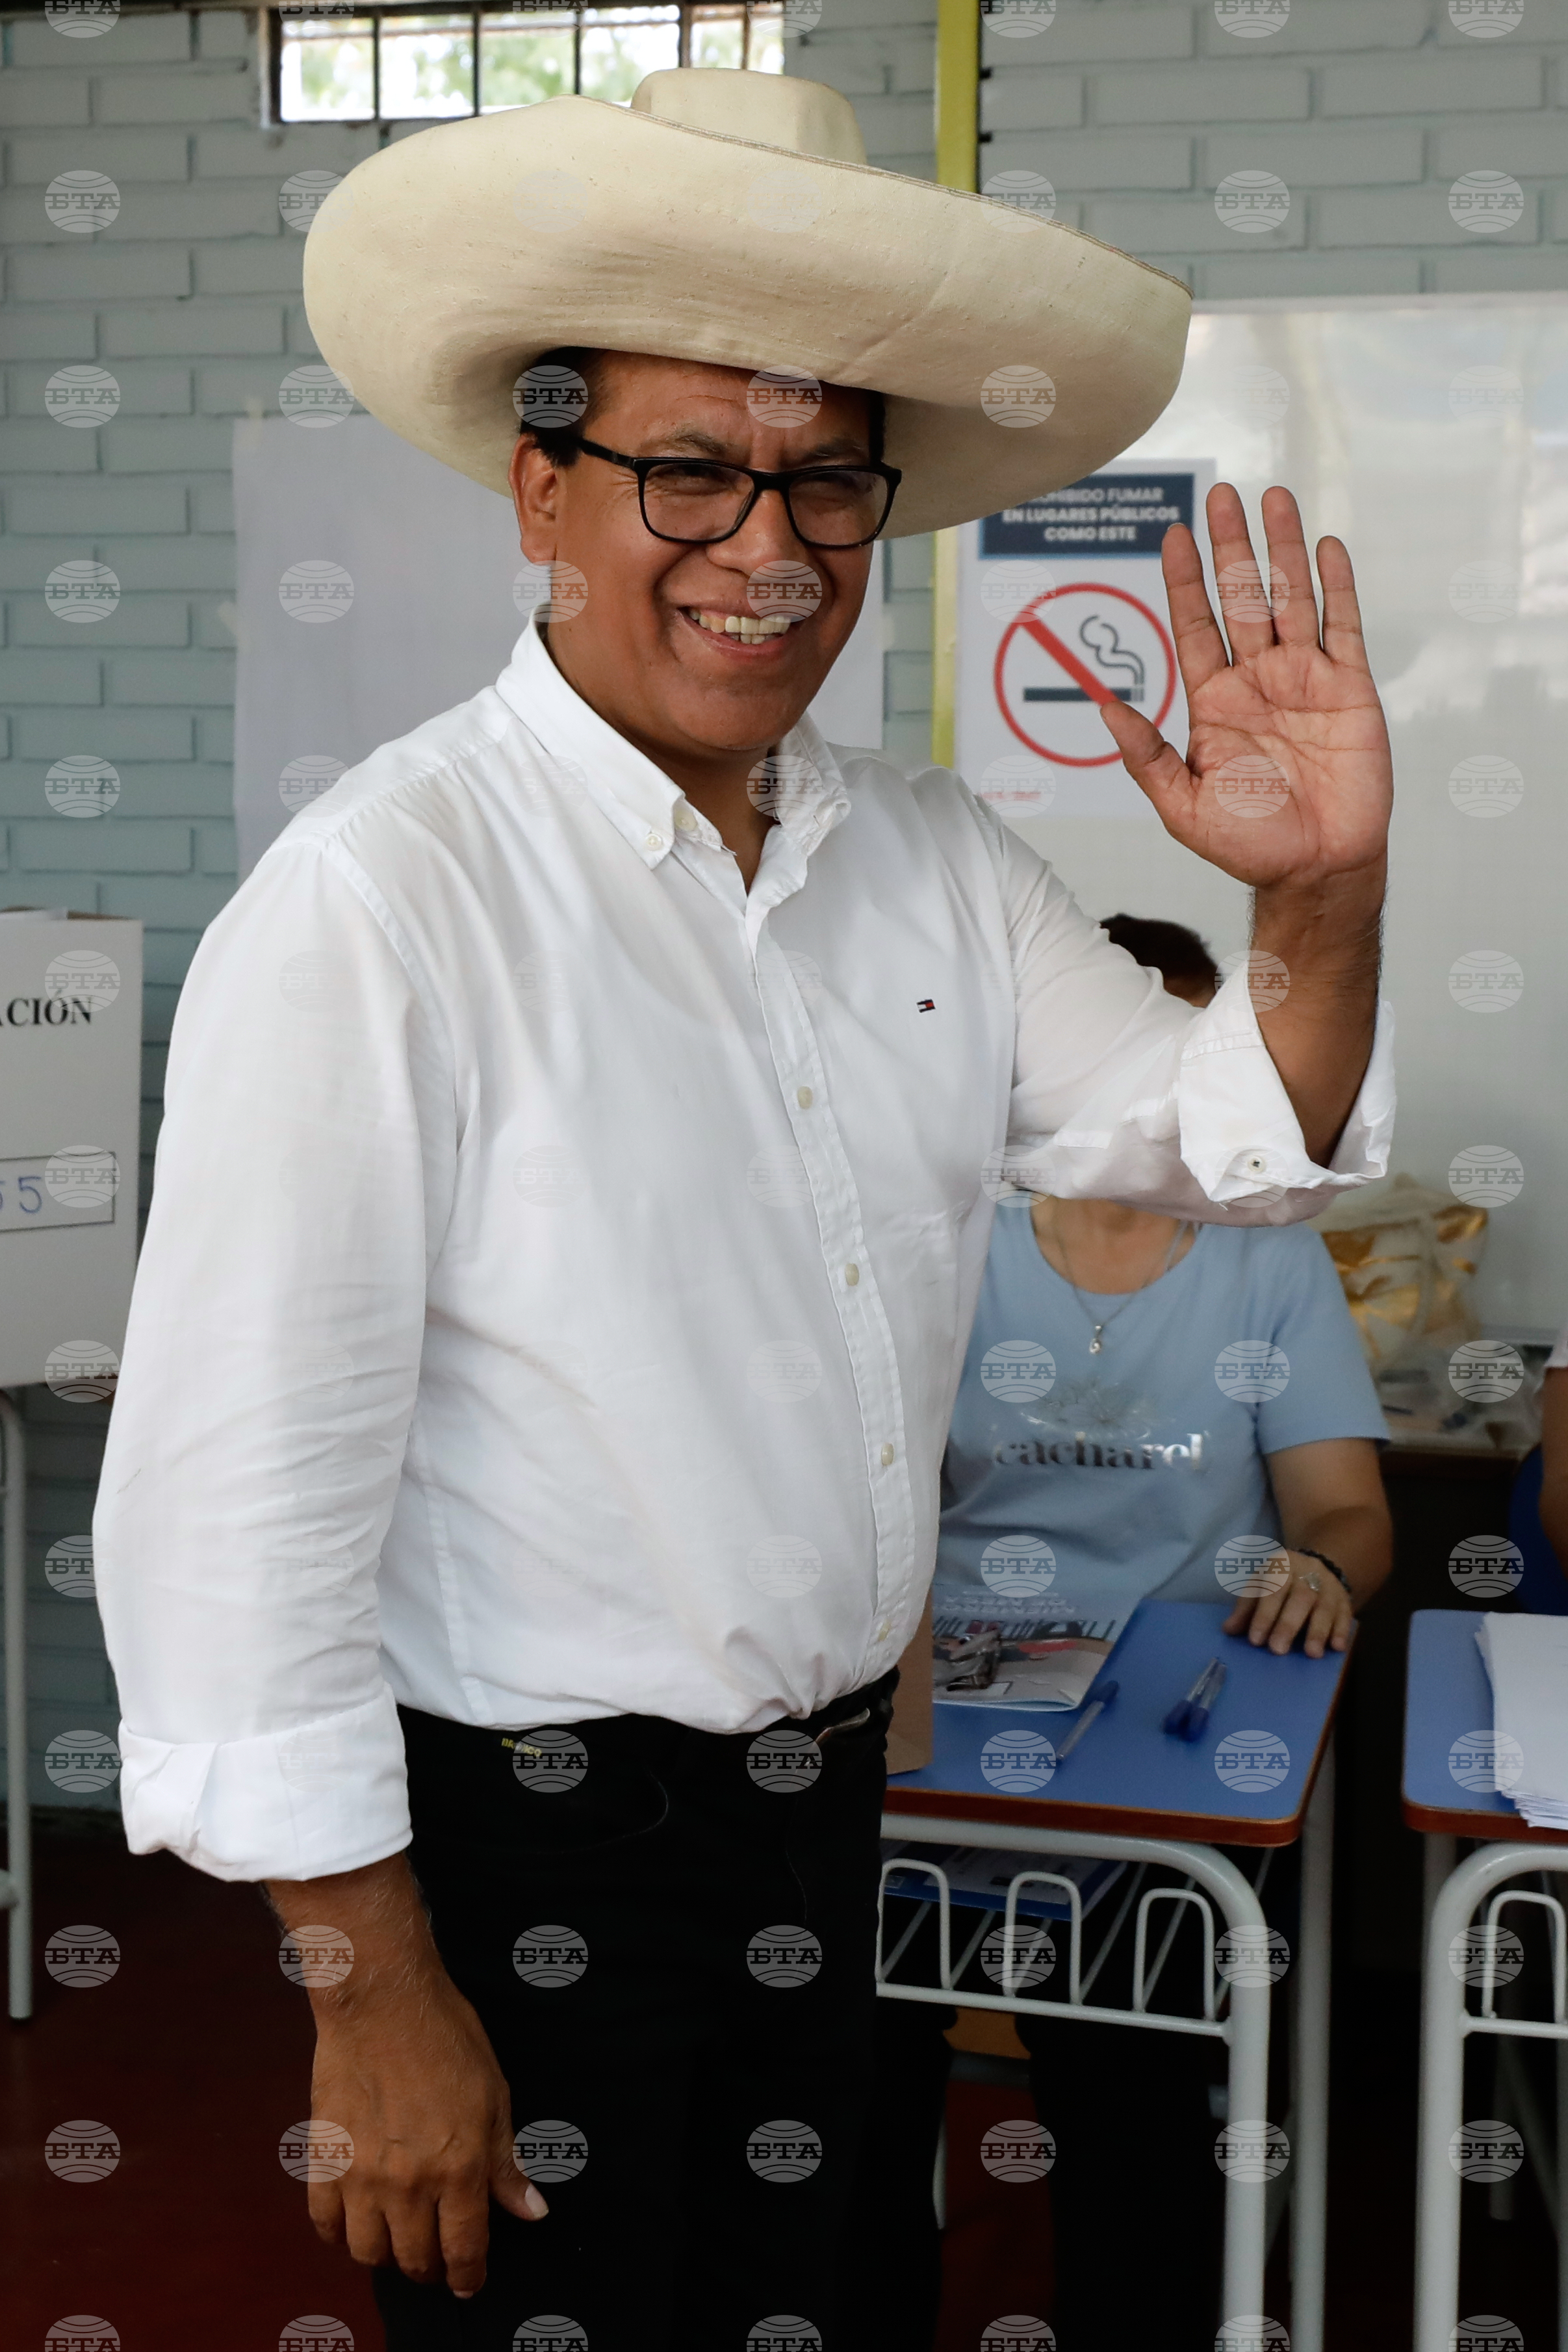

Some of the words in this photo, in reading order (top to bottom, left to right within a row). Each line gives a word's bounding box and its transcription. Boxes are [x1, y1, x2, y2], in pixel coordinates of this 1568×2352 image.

[1107, 487, 1163, 502] FUMAR
[1003, 508, 1023, 523] EN
[1025, 507, 1097, 523] LUGARES
[1044, 526, 1097, 541] COMO
[1098, 526, 1137, 541] ESTE
[0, 989, 92, 1026] CIÓN
